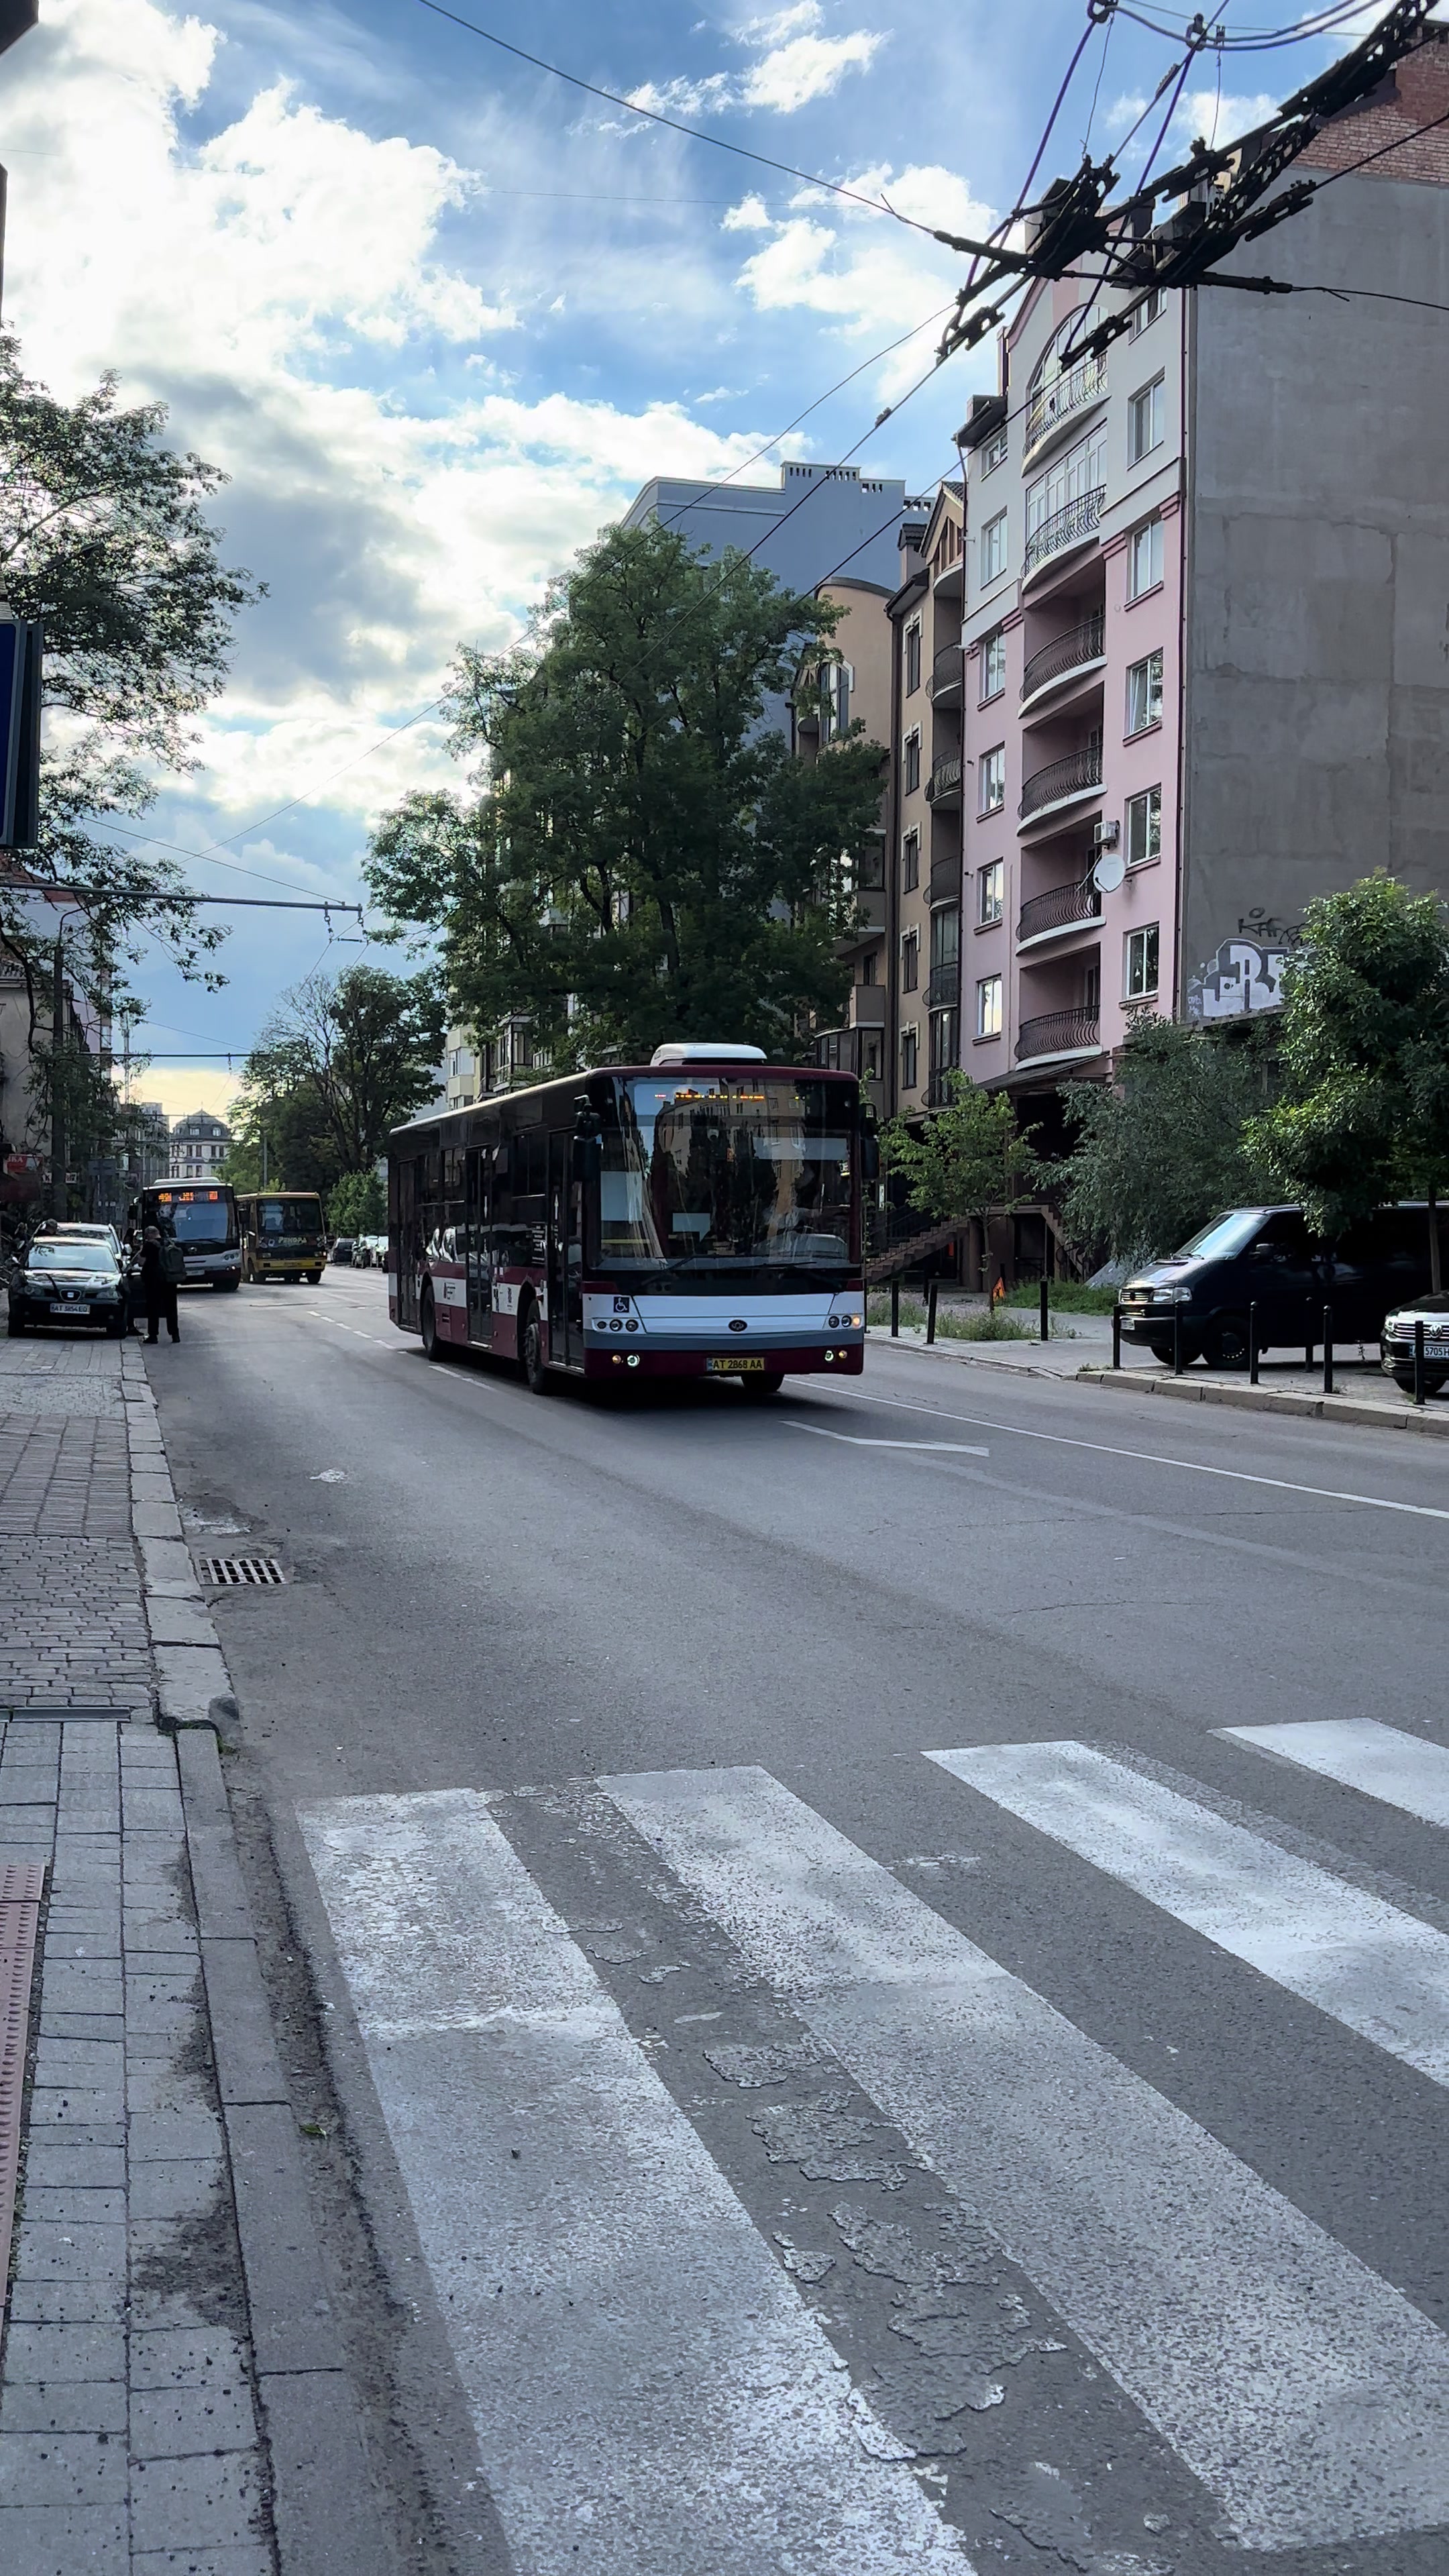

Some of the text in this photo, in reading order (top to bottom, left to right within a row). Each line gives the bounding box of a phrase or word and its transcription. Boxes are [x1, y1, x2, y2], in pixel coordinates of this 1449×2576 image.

[713, 1360, 763, 1369] AT 2868 AA
